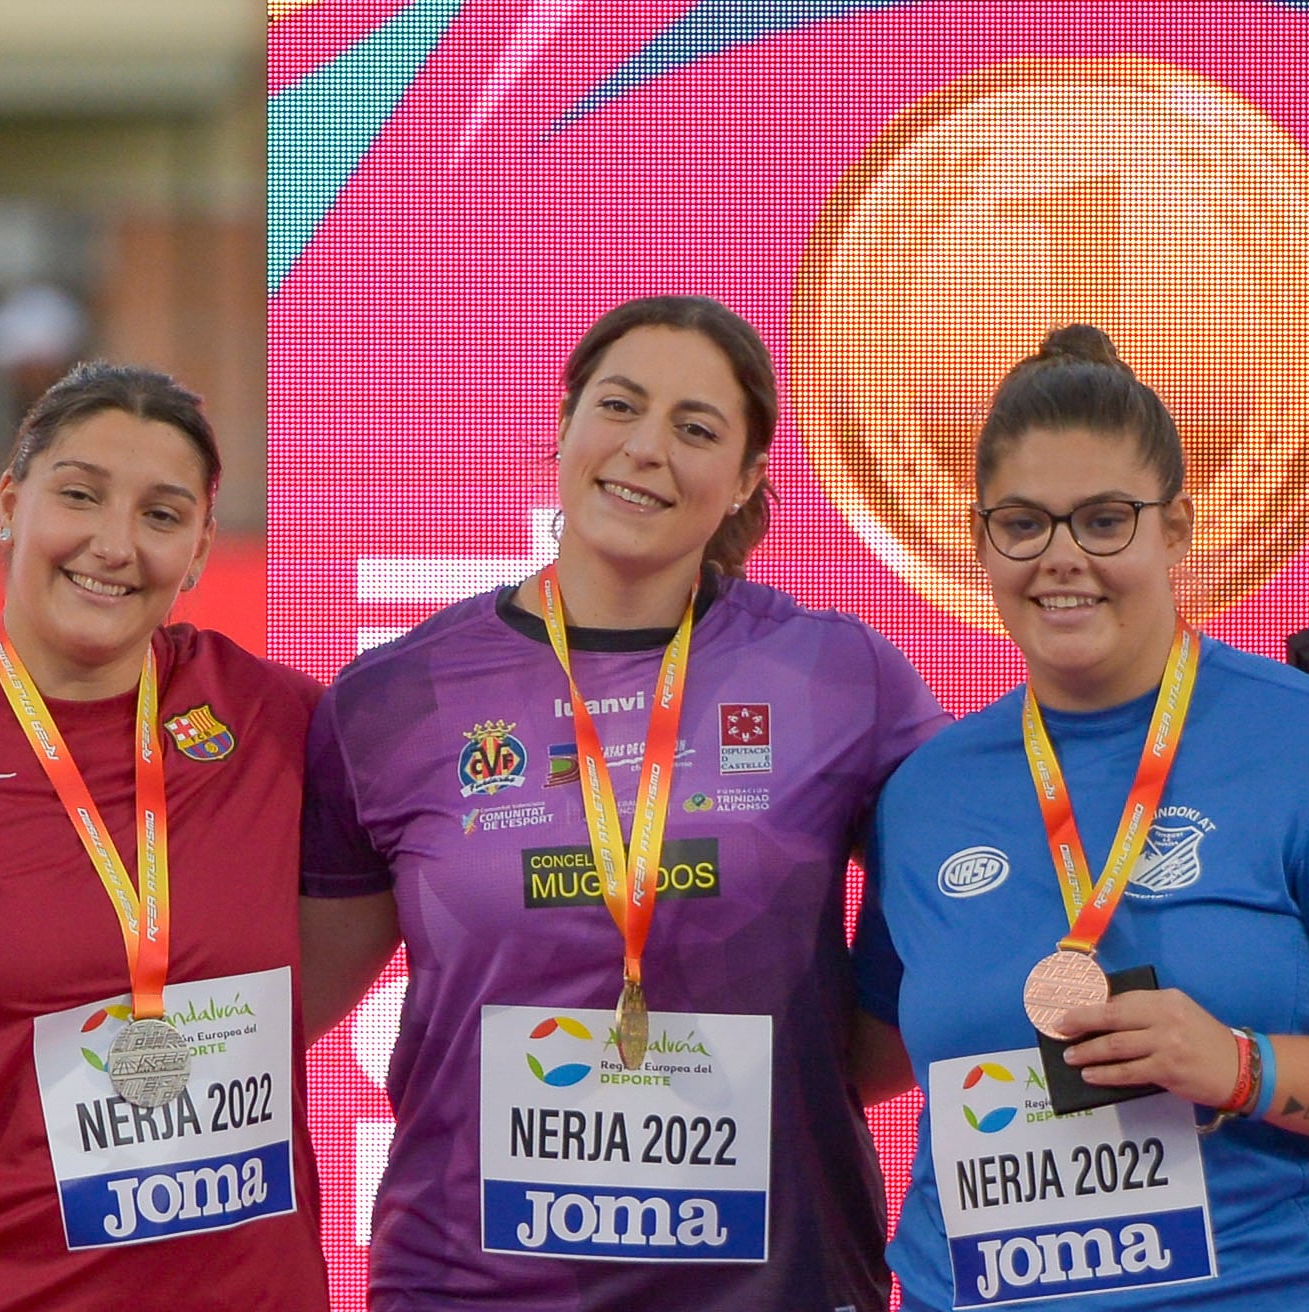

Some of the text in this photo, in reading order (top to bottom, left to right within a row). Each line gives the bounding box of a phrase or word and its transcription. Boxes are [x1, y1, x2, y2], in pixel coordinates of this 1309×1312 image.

[554, 691, 645, 718] luanvi
[30, 719, 60, 761] RFEA
[1152, 712, 1172, 757] RFEA
[1036, 760, 1056, 801] RFEA
[716, 794, 770, 803] TRINIDAD
[716, 803, 770, 811] ALFONSO
[1153, 806, 1200, 821] INDOKI
[479, 806, 546, 823] COMUNITAT
[483, 813, 555, 831] DE L'ESPORT
[586, 755, 619, 897] RFEA ATLETISMO
[632, 763, 661, 907] RFEA ATLETISMO
[530, 853, 594, 869] CONCEL
[1093, 803, 1144, 909] RFEA ATLETISMO
[145, 809, 160, 942] RFEA ATLETISMO
[531, 861, 715, 899] MUGDOS
[167, 992, 256, 1028] ndalucía
[197, 1028, 243, 1044] Europea
[243, 1024, 258, 1036] del
[603, 1027, 713, 1057] Aalucía
[189, 1042, 227, 1058] ORTE
[600, 1073, 671, 1086] DEPORTE
[645, 1062, 691, 1075] Europea
[693, 1064, 713, 1074] del
[76, 1072, 273, 1153] NERJA 2022
[1024, 1098, 1051, 1112] Regi
[510, 1106, 738, 1166] NERJA 2022
[956, 1137, 1169, 1211] NERJA 2022
